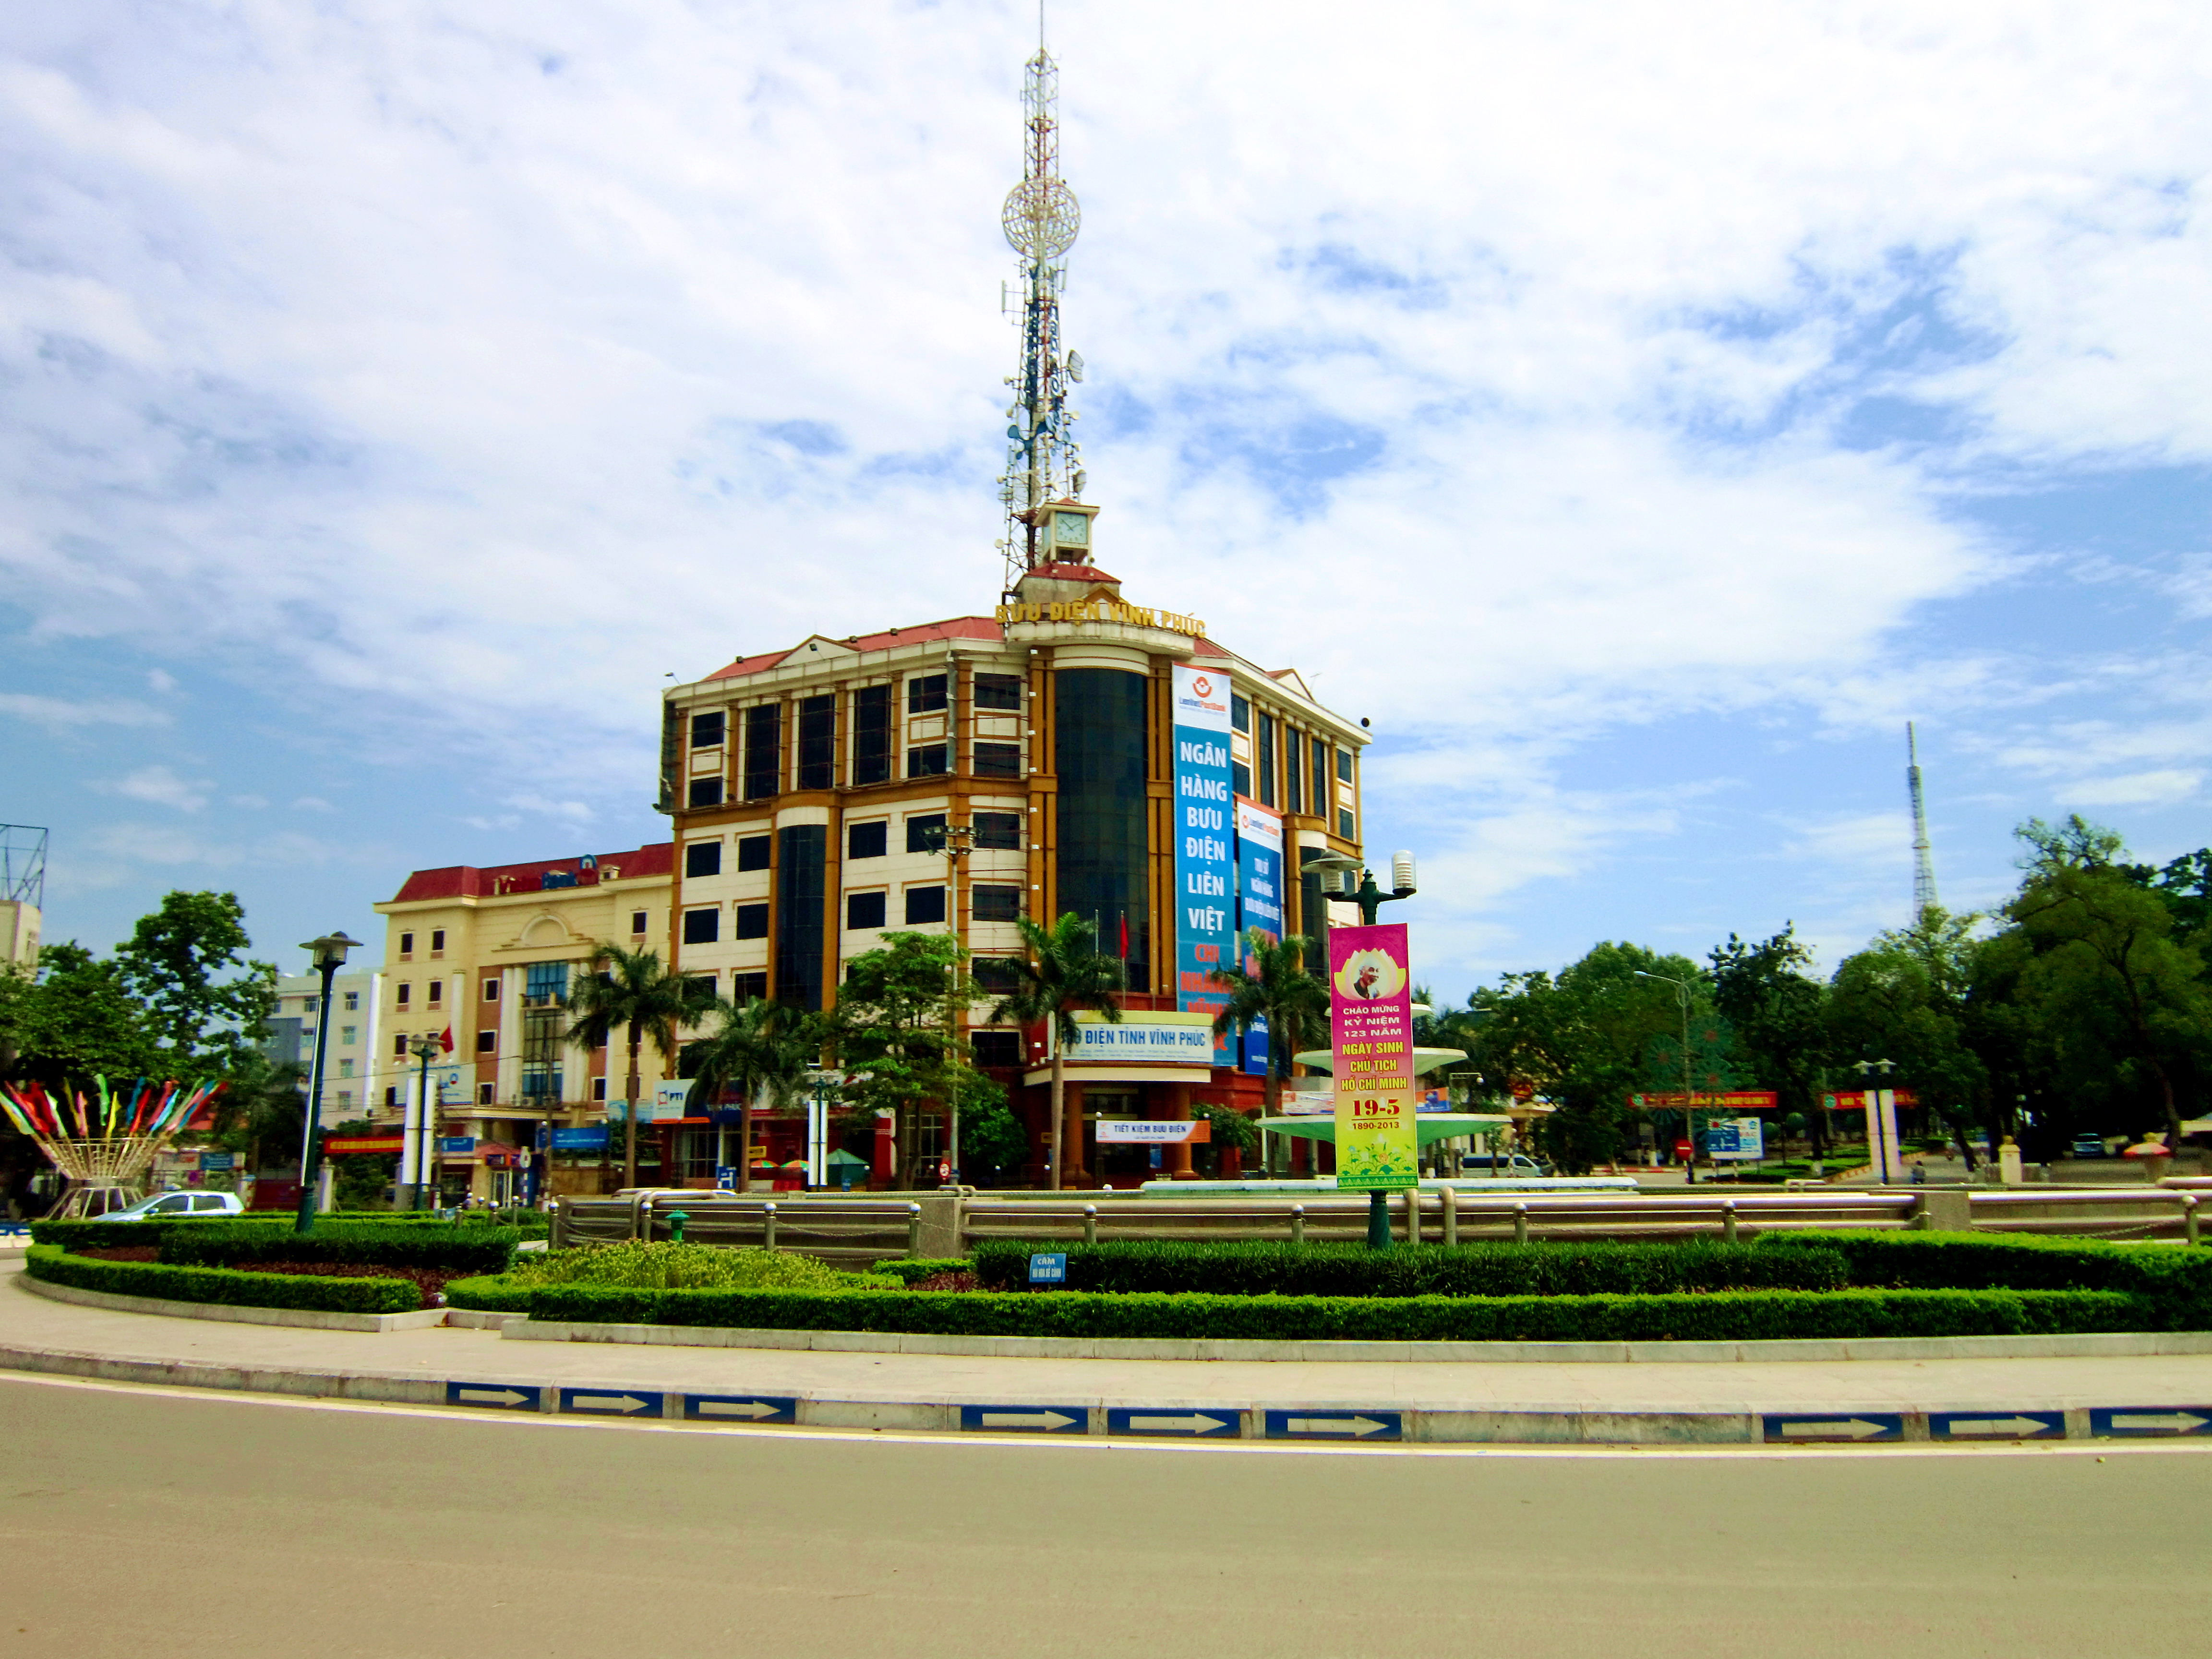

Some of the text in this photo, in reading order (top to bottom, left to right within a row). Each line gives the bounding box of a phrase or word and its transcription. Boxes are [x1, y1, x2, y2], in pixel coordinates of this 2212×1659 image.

[995, 603, 1041, 623] BƯU
[1162, 612, 1206, 638] PHÚC
[1180, 741, 1226, 768] NGÂN
[1181, 773, 1227, 801] HÀNG
[1187, 806, 1222, 830] BƯU
[1185, 836, 1226, 865] ĐIỆN
[1188, 871, 1224, 896] LIÊN
[1188, 906, 1226, 936] VIỆT
[1195, 944, 1220, 962] CHI
[1343, 1004, 1400, 1015] CHÀO MỪNG
[1344, 1015, 1400, 1026] KỶ NIỆM
[1085, 1027, 1115, 1047] ĐIỆN
[1118, 1026, 1145, 1045] TỈNH
[1150, 1028, 1176, 1045] VĨNH
[1179, 1029, 1205, 1046] PHÚC
[1370, 1027, 1402, 1036] NĂM
[1342, 1041, 1404, 1055] NGÀY SINH
[1349, 1056, 1397, 1074] CHỦ TỊCH
[1341, 1075, 1407, 1091] HỒ CHÍ MINH
[1352, 1099, 1400, 1116] 19-5
[1352, 1121, 1400, 1130] 1890-2013
